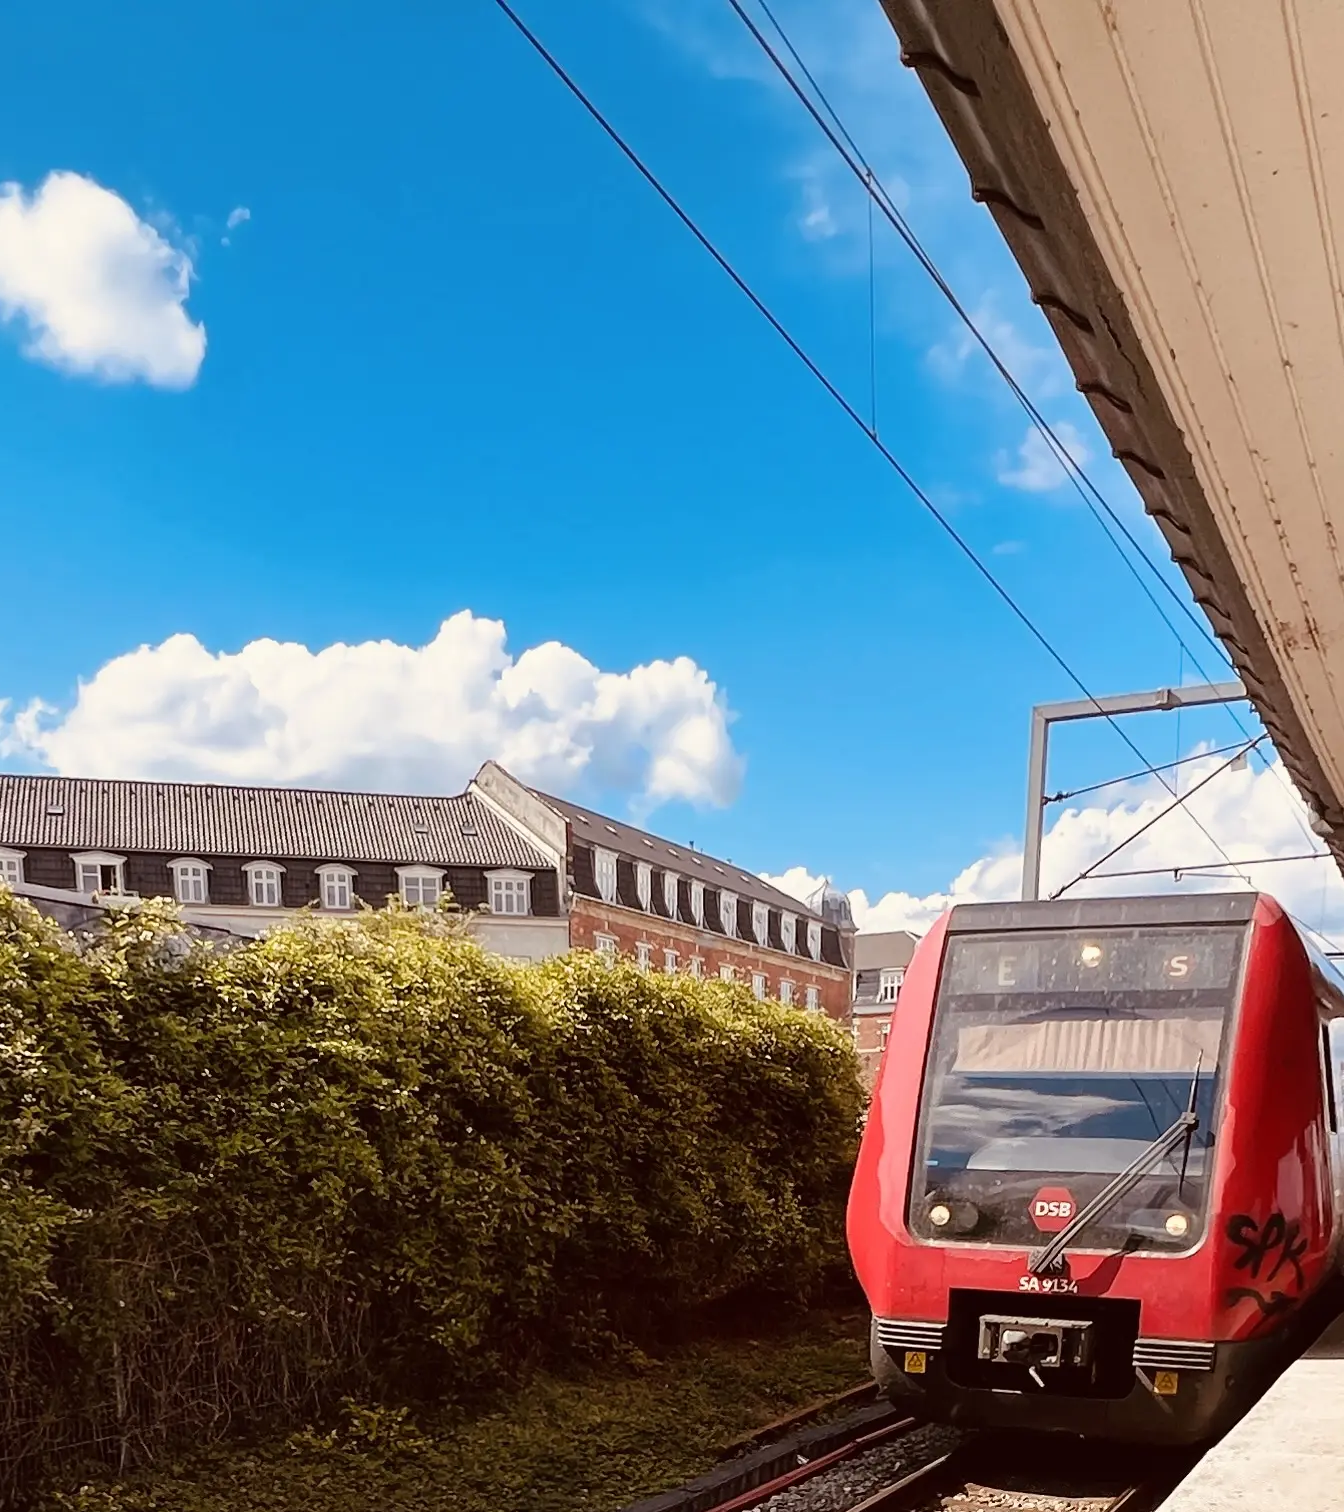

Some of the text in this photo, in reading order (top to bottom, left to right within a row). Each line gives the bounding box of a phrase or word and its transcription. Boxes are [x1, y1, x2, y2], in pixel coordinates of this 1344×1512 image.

[998, 956, 1017, 986] E
[1169, 955, 1188, 976] S
[1035, 1201, 1071, 1217] DSB
[1018, 1276, 1078, 1294] SA 9134
